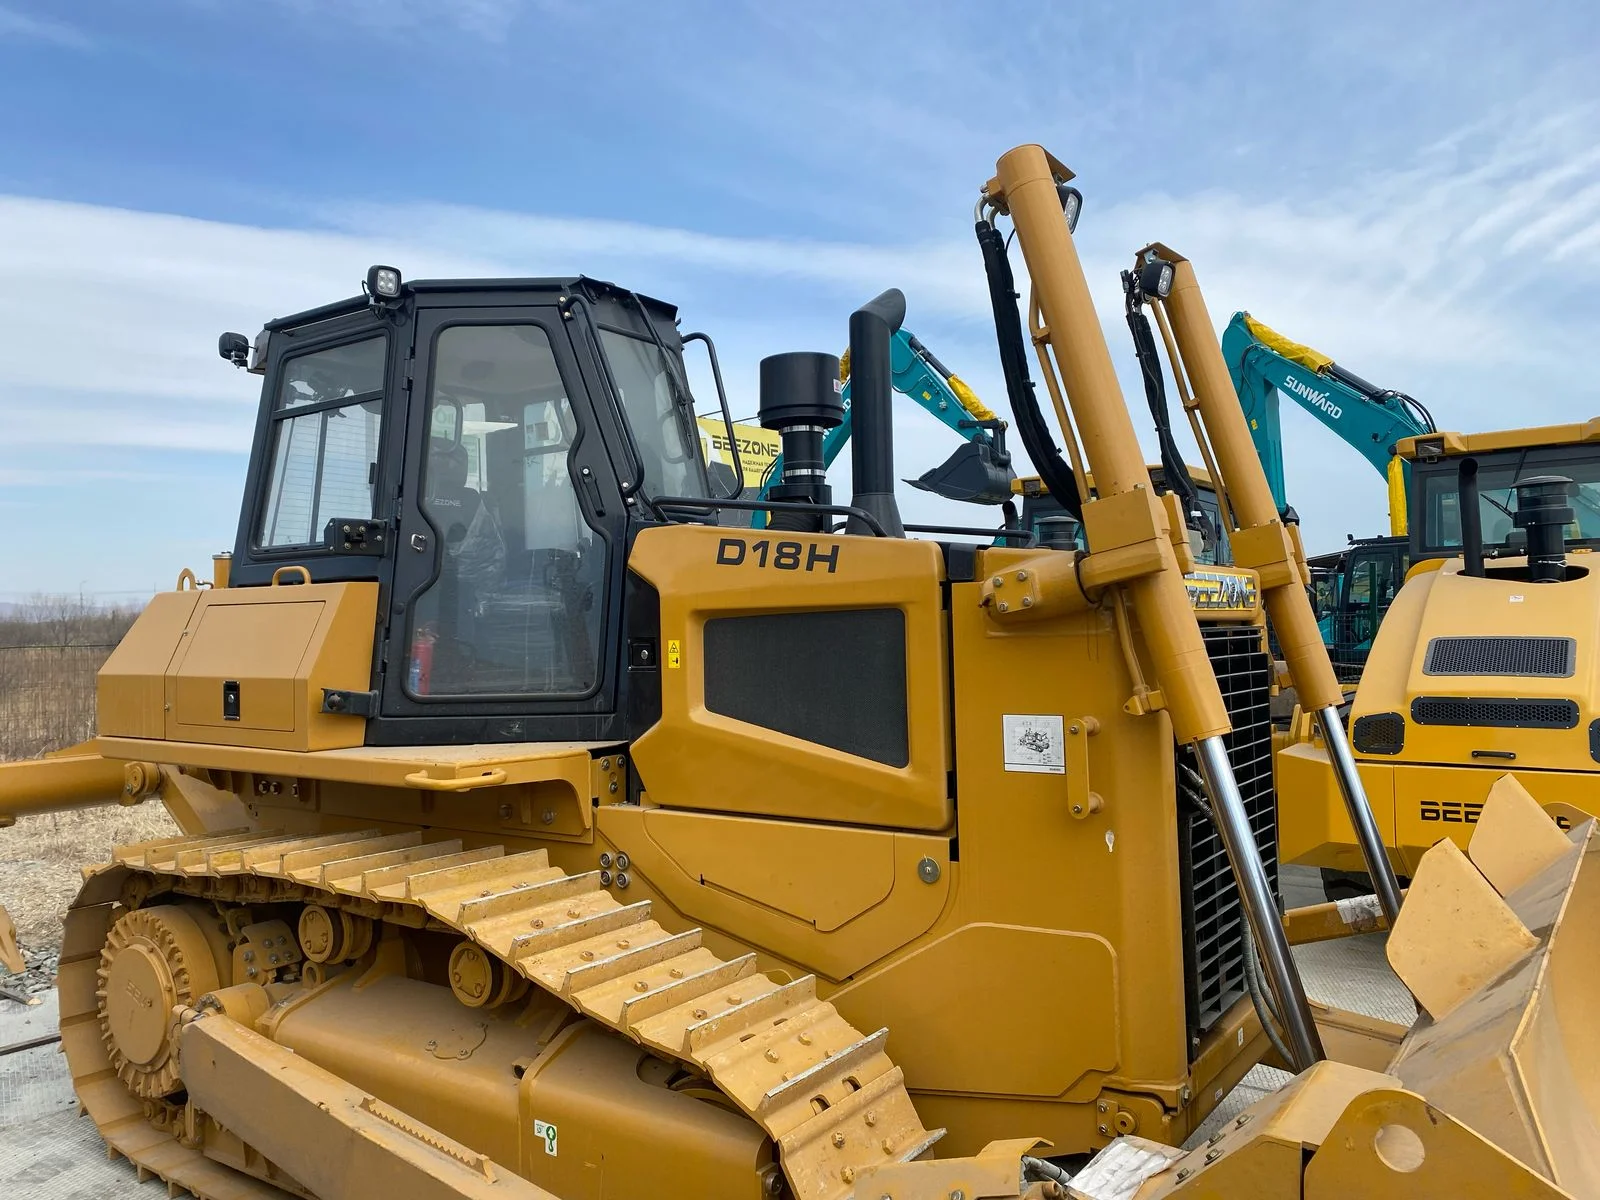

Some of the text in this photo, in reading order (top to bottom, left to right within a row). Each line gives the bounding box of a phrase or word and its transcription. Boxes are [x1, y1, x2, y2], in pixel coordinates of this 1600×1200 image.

[1283, 375, 1343, 419] SUNWARD
[712, 435, 779, 457] BEEZONE
[716, 538, 840, 574] D18H
